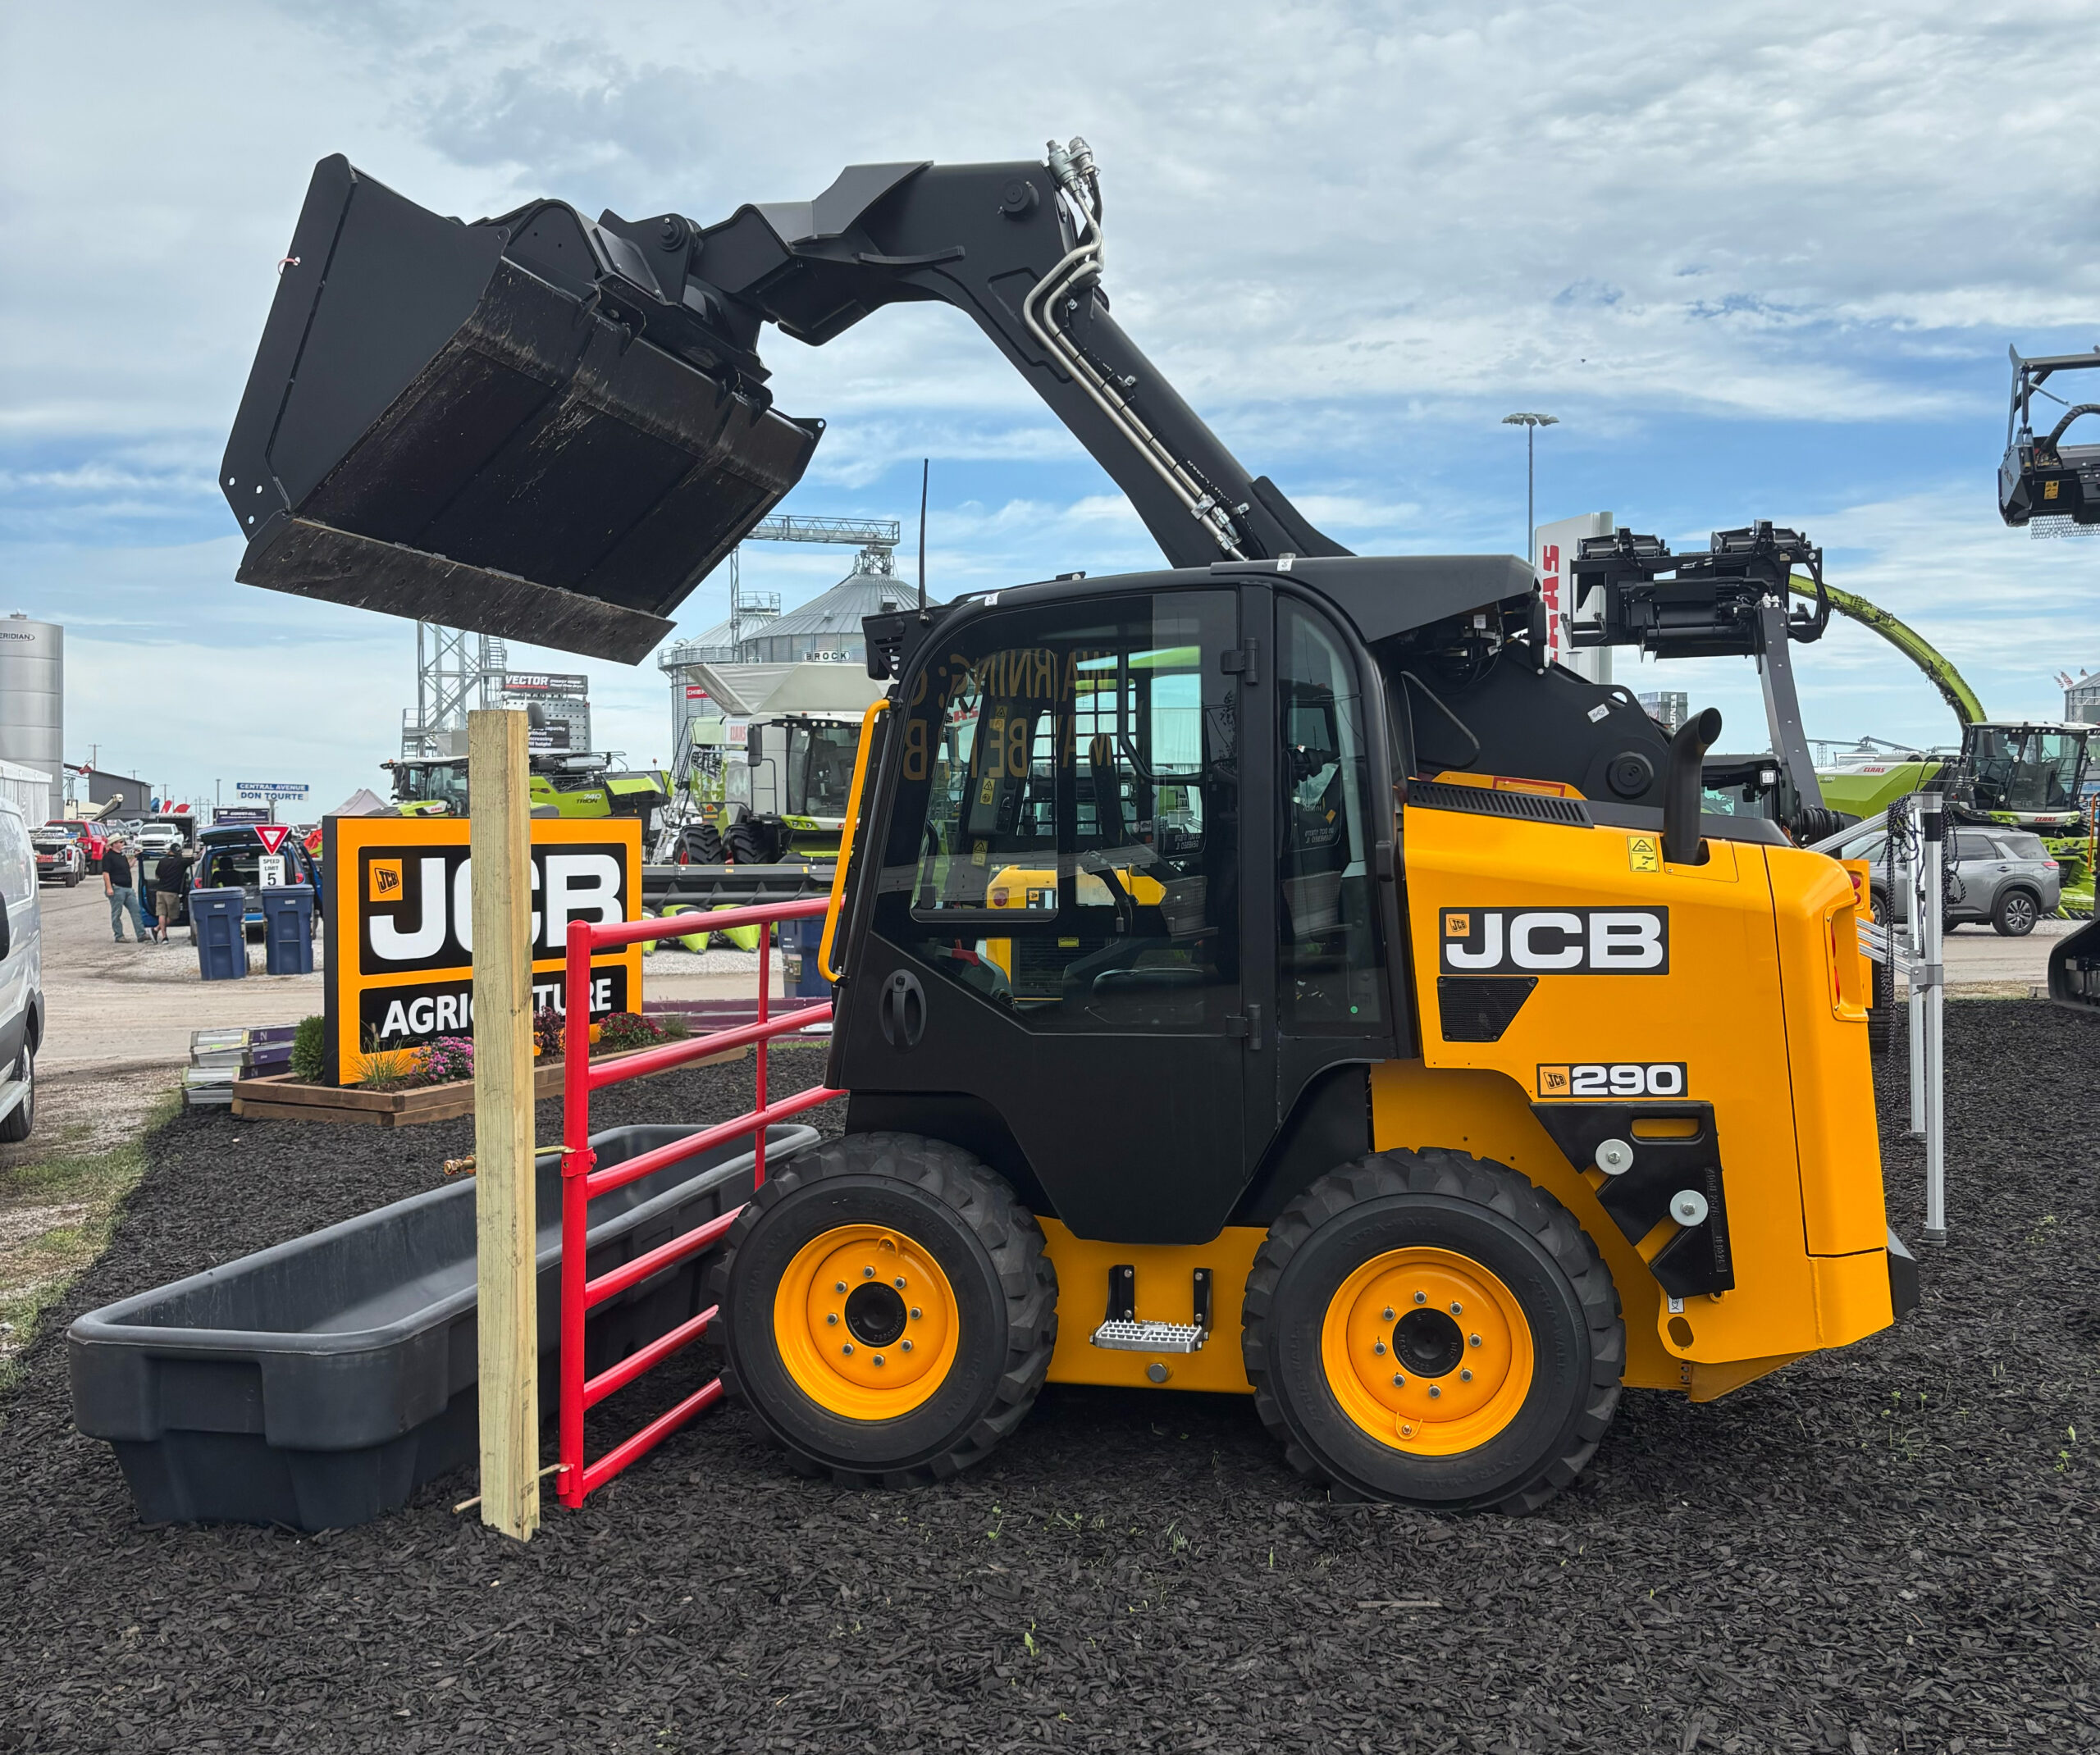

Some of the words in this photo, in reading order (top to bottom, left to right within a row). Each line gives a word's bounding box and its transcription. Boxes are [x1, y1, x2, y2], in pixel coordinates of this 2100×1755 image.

[1543, 545, 1559, 661] AAS
[806, 651, 848, 660] BROCK
[505, 675, 550, 686] VECTOR
[264, 792, 304, 800] TOURTE
[267, 873, 276, 886] 5
[377, 868, 399, 892] JCB
[1451, 919, 1467, 931] JCB
[1446, 913, 1664, 969] JCB
[381, 978, 612, 1037] AGRITUE
[1547, 1073, 1566, 1087] JCB
[1572, 1064, 1682, 1095] 290
